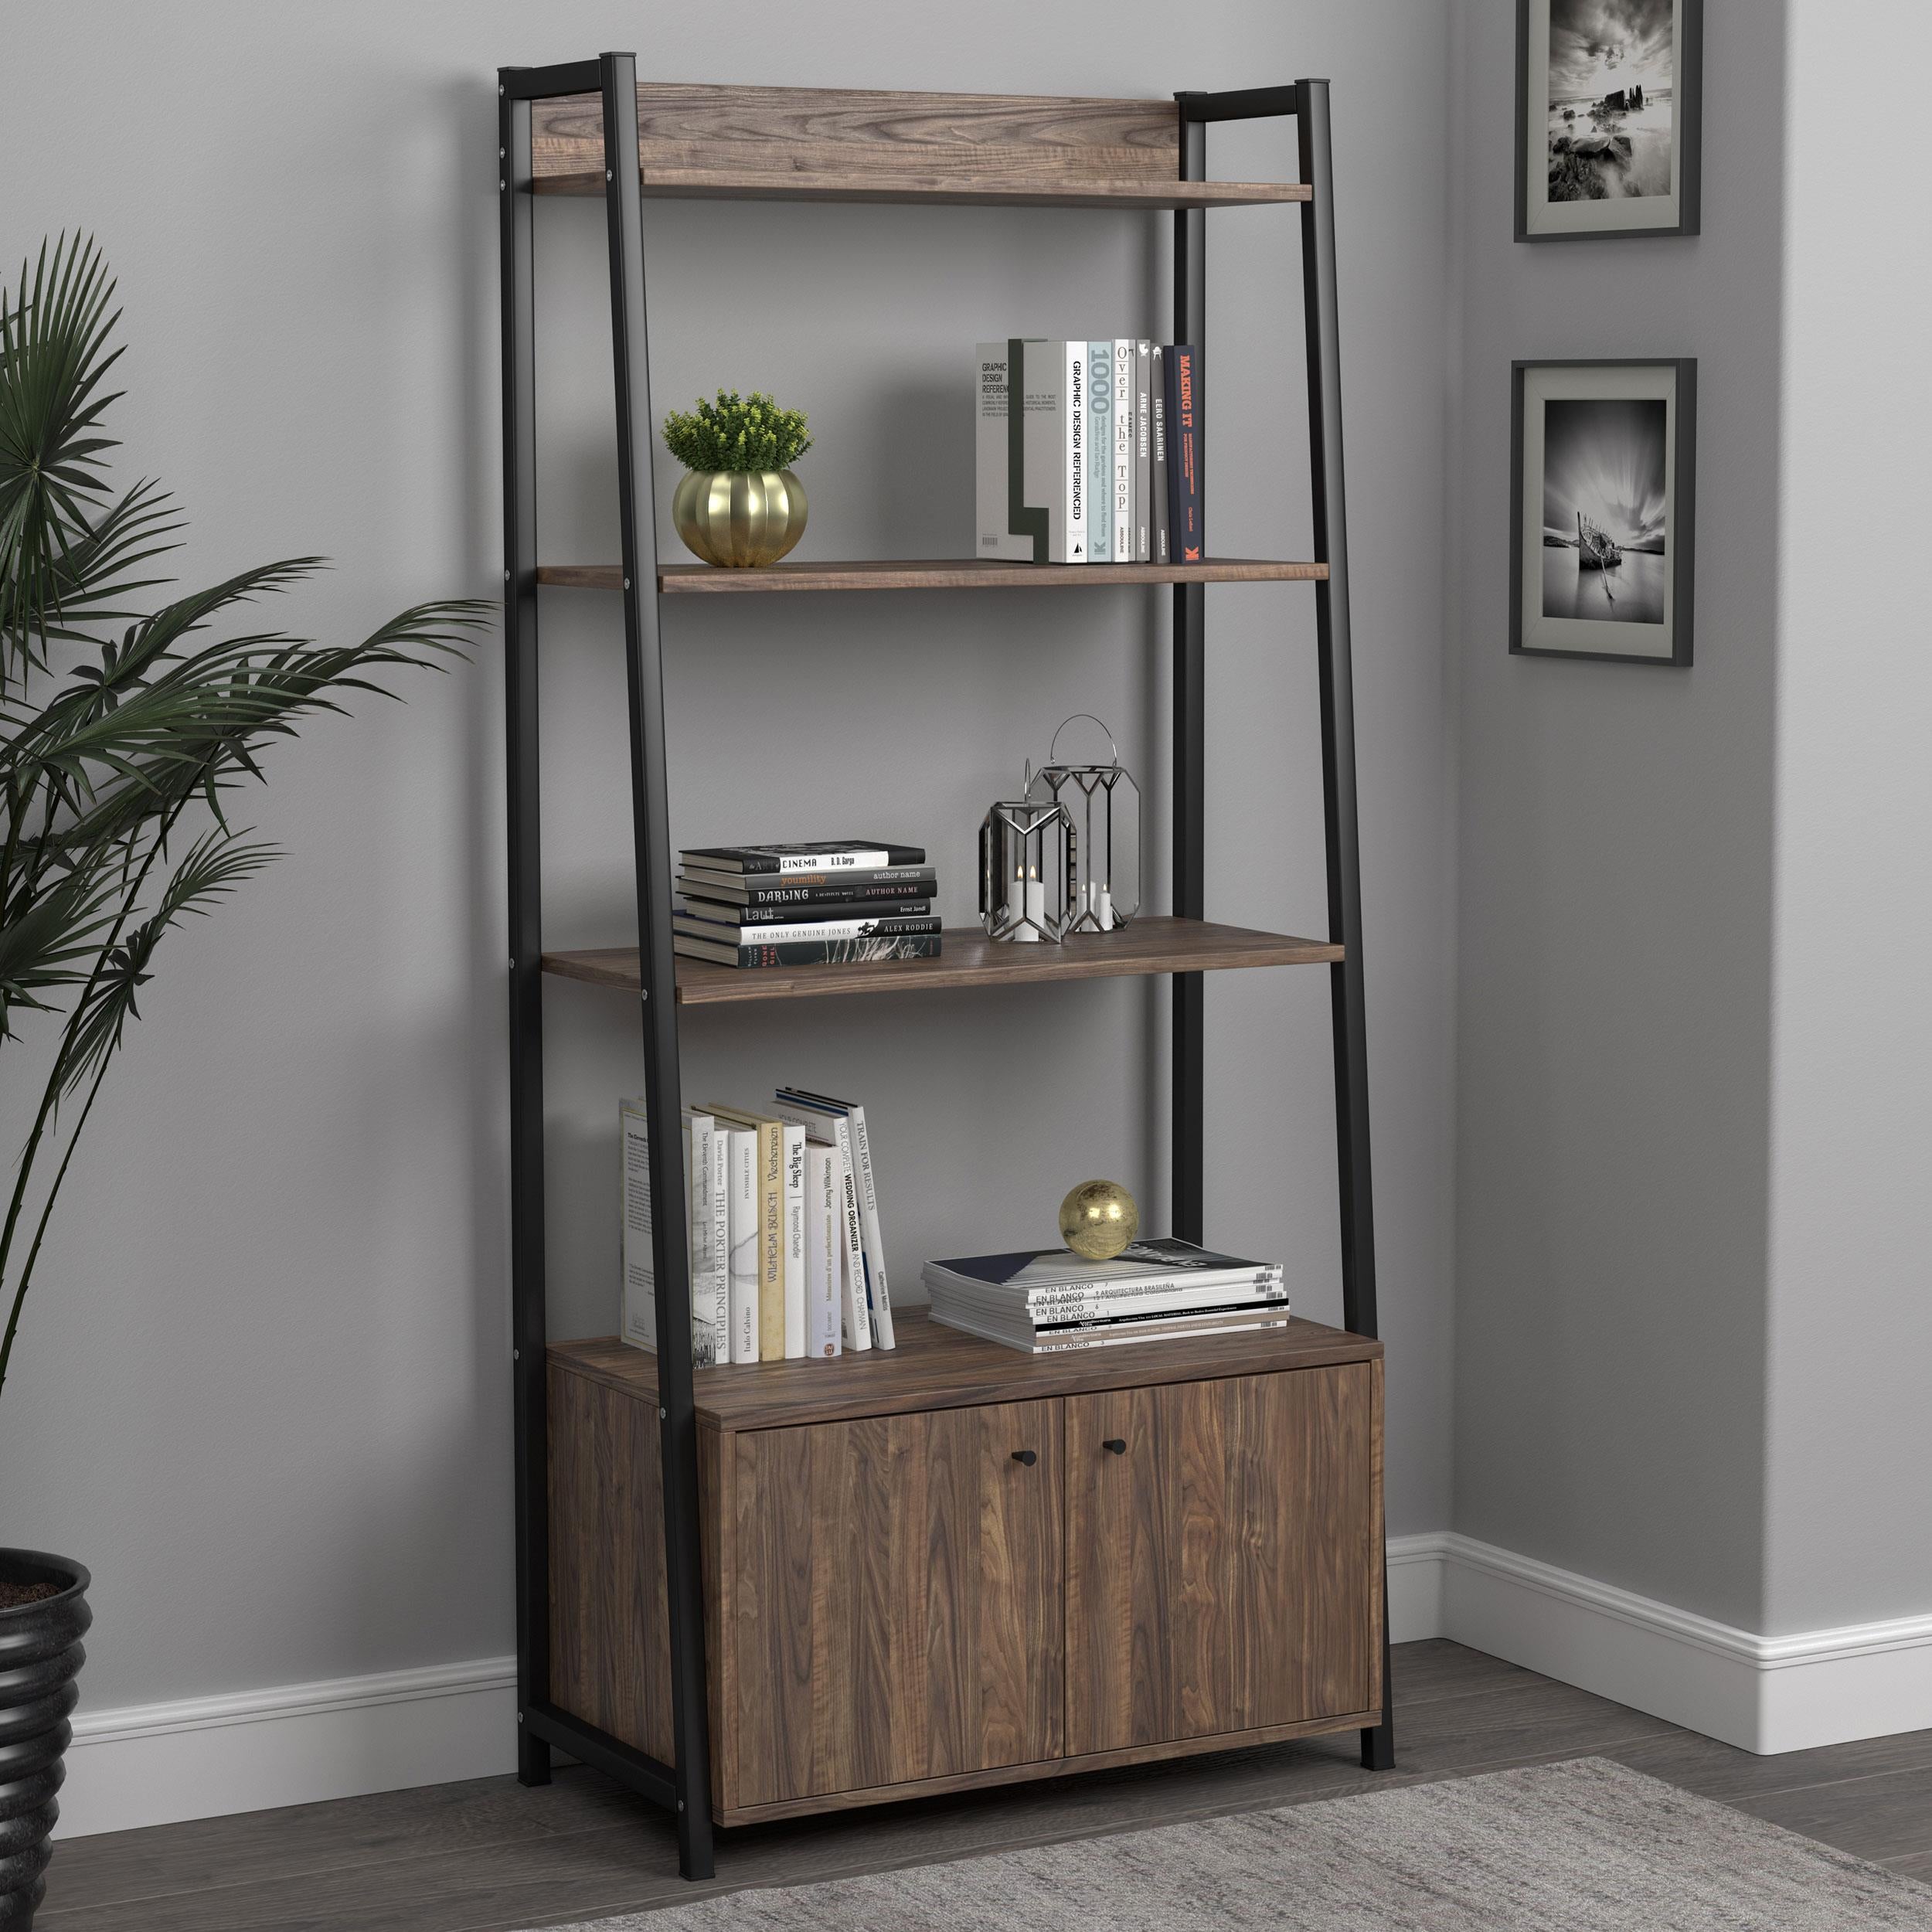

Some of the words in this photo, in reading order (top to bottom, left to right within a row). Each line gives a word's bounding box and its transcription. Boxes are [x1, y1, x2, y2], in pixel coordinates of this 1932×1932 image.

[982, 362, 1007, 372] GRAPHIC
[982, 374, 1002, 383] DESIGN
[1091, 349, 1110, 414] 1000
[1180, 355, 1192, 410] MAKING
[1182, 413, 1192, 427] IT
[782, 859, 817, 869] CINEMA
[831, 857, 835, 866] B.
[781, 874, 827, 886] youmility
[758, 889, 809, 903] DARLING
[866, 887, 895, 896] AUTHOR
[792, 929, 825, 937] GENUINE
[828, 927, 851, 936] JONES
[905, 923, 934, 931] RODDIE
[839, 1122, 848, 1140] YOUR
[857, 1121, 867, 1151] TRAIN
[792, 1142, 802, 1155] The
[841, 1141, 851, 1173] COMPLETE
[789, 1156, 802, 1169] Big
[861, 1152, 869, 1172] FOR
[789, 1169, 802, 1188] Sleep
[824, 1189, 833, 1209] Jonny
[845, 1174, 855, 1209] WEDDING
[864, 1172, 876, 1211] RESULTS
[716, 1190, 726, 1216] THE
[791, 1206, 801, 1233] Raymond
[849, 1210, 859, 1252] ORGANIZER
[716, 1220, 726, 1271] PORTER
[793, 1233, 801, 1259] Chandler
[854, 1269, 863, 1294] RECORD
[1058, 1284, 1094, 1292] BLANCO
[1049, 1292, 1084, 1301] BLANCO
[1100, 1286, 1143, 1296] ARQUITECTURA
[1144, 1282, 1175, 1291] BRASILEÑA
[716, 1275, 726, 1350] PRINCIPLES
[857, 1297, 867, 1330] CHAPMAN
[1049, 1304, 1084, 1315] BLANCO
[1060, 1311, 1095, 1321] BLANCO
